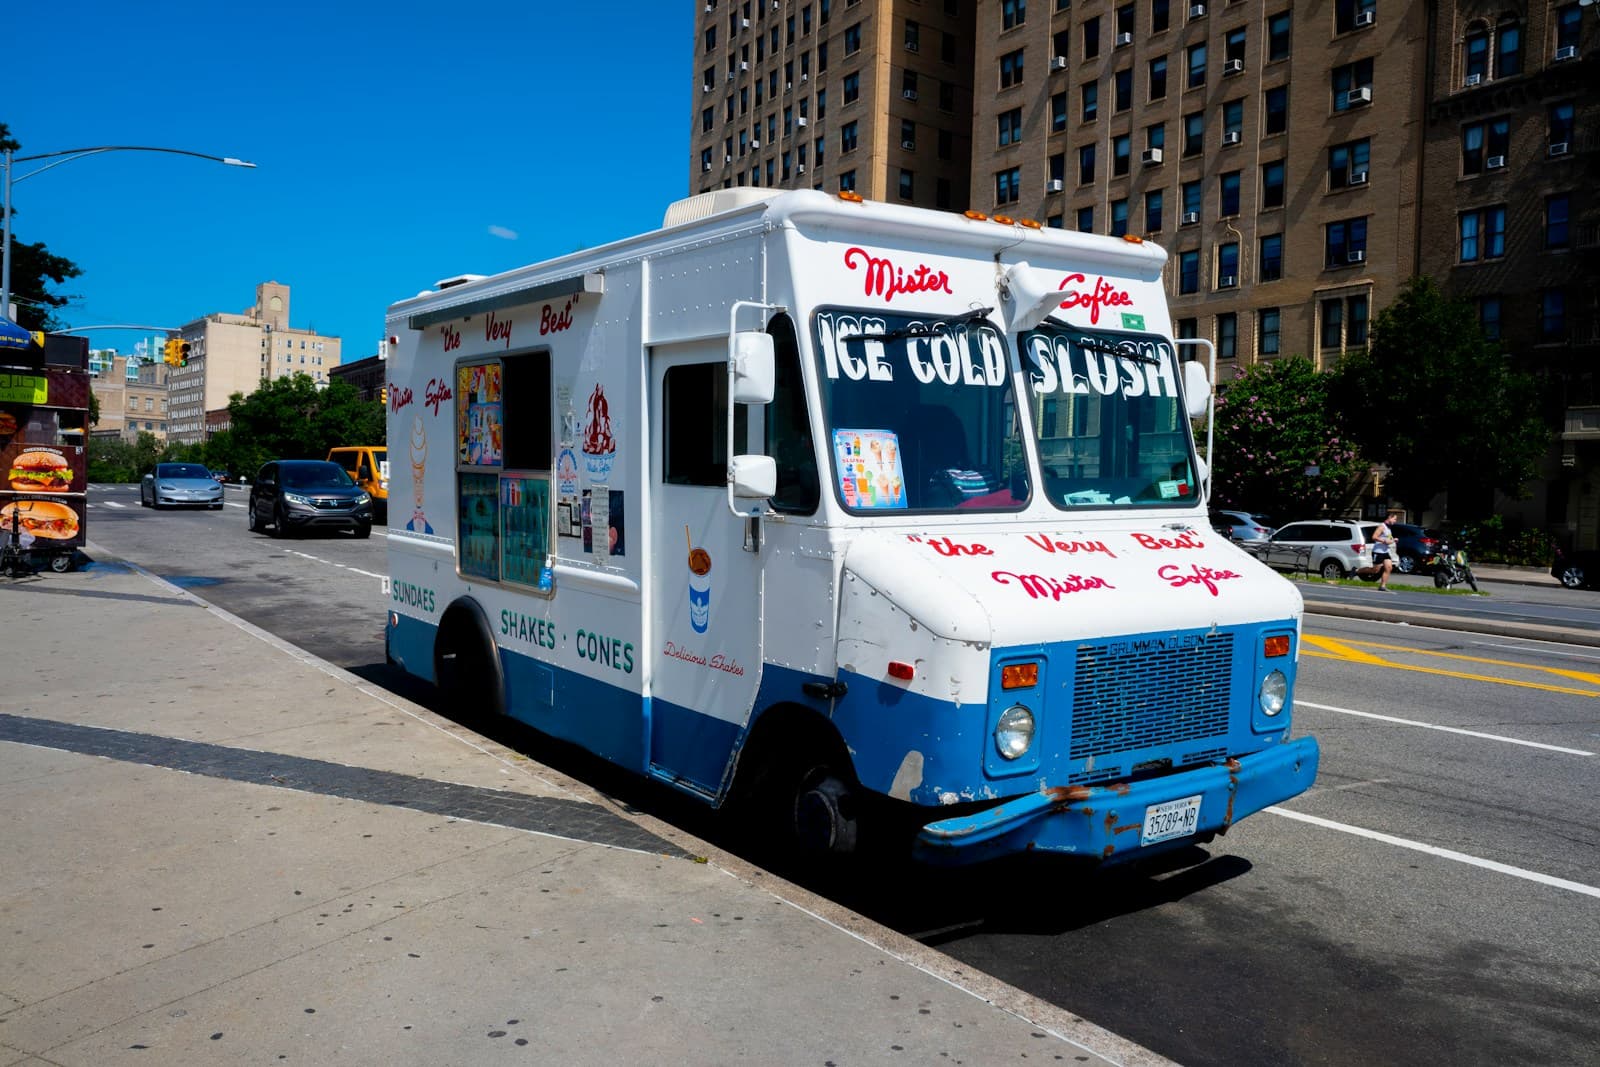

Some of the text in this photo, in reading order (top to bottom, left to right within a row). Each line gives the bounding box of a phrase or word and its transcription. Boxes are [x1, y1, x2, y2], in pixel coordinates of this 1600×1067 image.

[844, 247, 1134, 325] Mister Softee
[485, 311, 513, 349] Very
[816, 311, 1178, 400] ICE COLD SLUSH
[388, 378, 453, 417] Mister Softee
[1023, 533, 1118, 559] Very
[391, 579, 436, 614] SUNDAES
[991, 564, 1243, 601] Mister Softee
[500, 608, 635, 675] SHAKES CONES
[663, 641, 745, 678] Delicious Shakes
[1109, 634, 1205, 655] GRUMMAN OLSON
